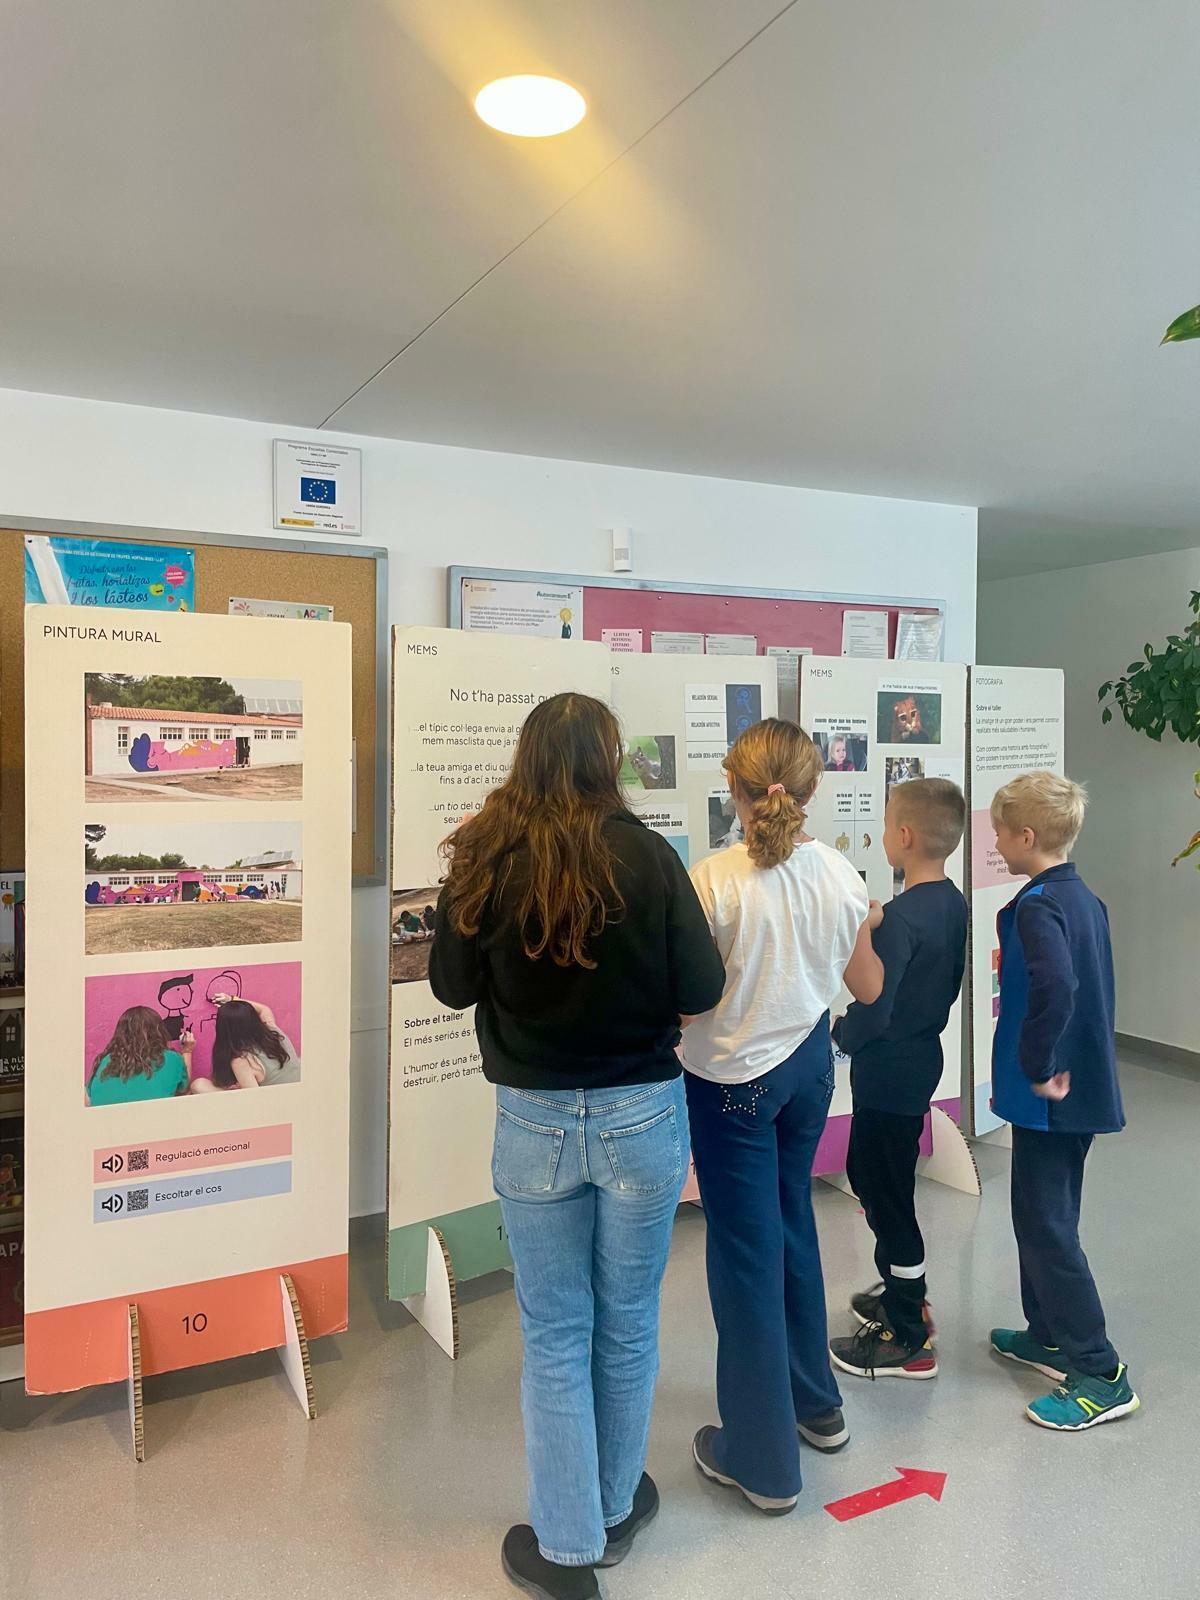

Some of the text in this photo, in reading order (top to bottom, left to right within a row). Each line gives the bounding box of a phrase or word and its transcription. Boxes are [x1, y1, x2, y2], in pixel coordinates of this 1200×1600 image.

[104, 588, 148, 604] lácteos
[43, 625, 162, 643] PINTURA MURAL
[407, 644, 438, 656] MEMS
[810, 669, 833, 678] MEMS
[450, 689, 468, 701] No
[497, 693, 535, 706] passat
[429, 724, 448, 733] típic
[484, 725, 505, 733] envia
[507, 725, 514, 733] al
[422, 737, 444, 745] mem
[446, 737, 485, 746] masclista
[486, 738, 502, 748] que
[503, 738, 511, 748] ja
[426, 763, 445, 772] teua
[447, 763, 472, 773] amiga
[474, 764, 483, 772] et
[485, 763, 497, 771] diu
[440, 776, 455, 785] fins
[491, 776, 507, 784] tres
[447, 802, 458, 811] tio
[460, 802, 473, 810] del
[404, 1012, 464, 1029] Sobre el taller
[404, 1038, 412, 1047] El
[414, 1034, 432, 1045] més
[434, 1030, 460, 1042] seriós
[461, 1028, 470, 1037] és
[440, 1059, 450, 1068] és
[452, 1055, 467, 1065] una
[403, 1066, 483, 1088] destruir, però tamb
[155, 1141, 250, 1164] Regulació emocional
[155, 1184, 222, 1202] Escoltar el cos
[182, 1313, 207, 1334] 10
